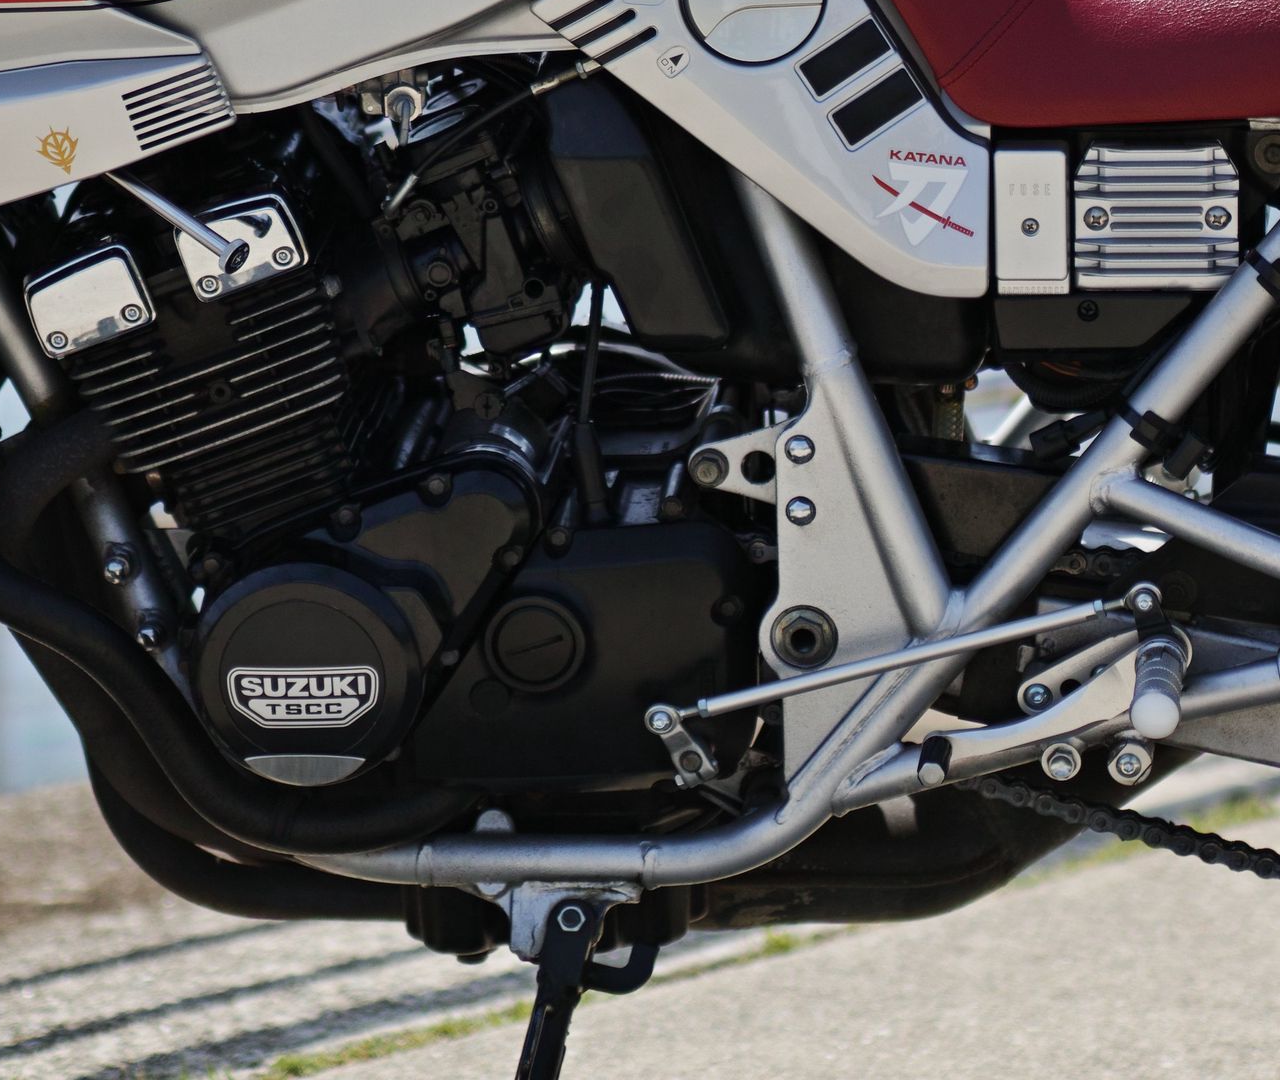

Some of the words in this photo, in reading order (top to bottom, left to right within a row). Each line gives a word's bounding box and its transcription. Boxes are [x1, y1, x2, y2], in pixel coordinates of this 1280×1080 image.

[660, 58, 676, 74] ON
[889, 149, 967, 168] KATANA
[1008, 183, 1052, 197] FUSE
[240, 675, 367, 698] SUZUKI
[265, 702, 343, 716] TSCC
